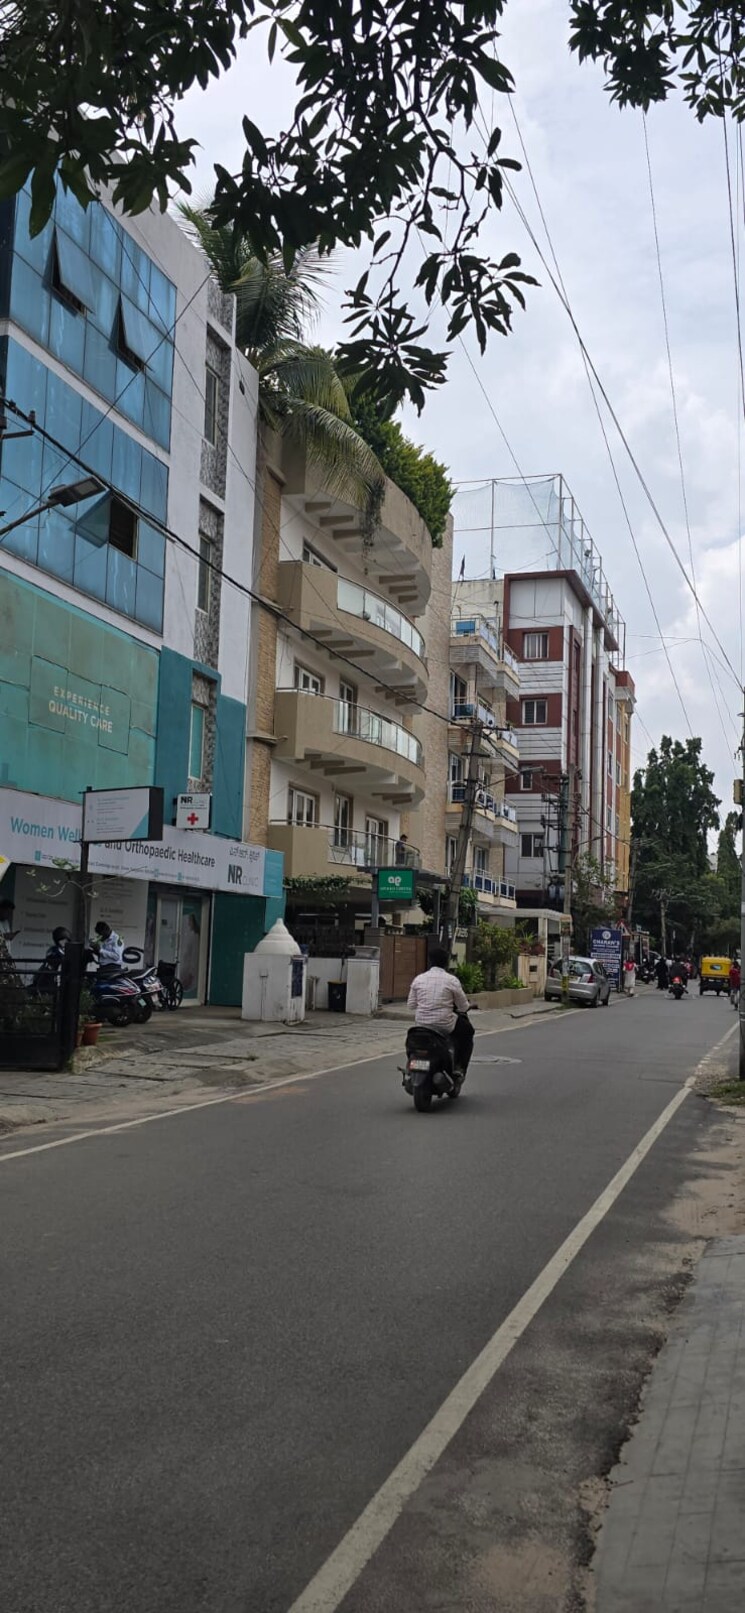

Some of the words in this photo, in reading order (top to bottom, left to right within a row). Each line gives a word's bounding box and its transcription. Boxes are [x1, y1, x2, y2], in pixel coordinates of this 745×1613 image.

[53, 686, 110, 716] EXPERIENCE
[48, 700, 89, 724] QUALITY
[90, 715, 113, 733] CARE
[180, 796, 193, 804] NR
[10, 816, 55, 839] Women
[124, 840, 176, 860] Orthopaedic
[177, 849, 216, 867] Healthcare
[227, 863, 243, 885] NR
